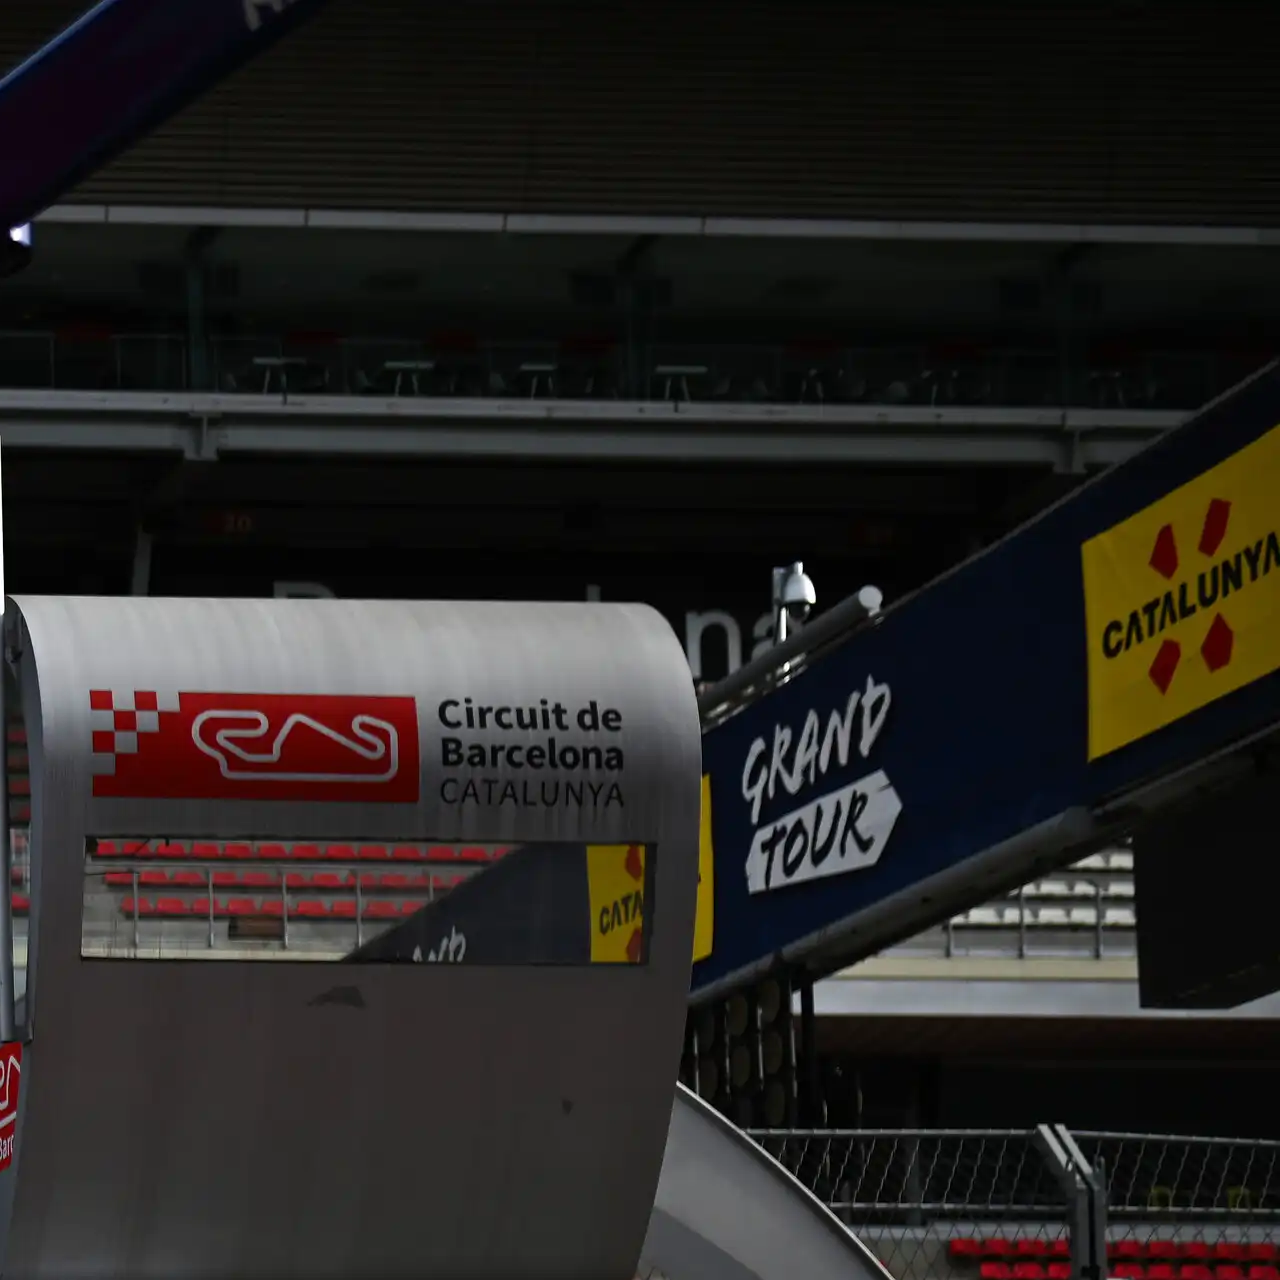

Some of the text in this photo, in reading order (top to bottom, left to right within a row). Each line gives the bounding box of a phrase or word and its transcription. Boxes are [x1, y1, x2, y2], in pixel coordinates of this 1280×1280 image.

[1101, 531, 1280, 658] CATALUNYA
[438, 698, 622, 732] Circuit de
[742, 674, 891, 824] GRAND
[442, 737, 624, 772] Barcelona
[440, 778, 624, 808] CATALUNYA
[761, 788, 874, 890] TOUR
